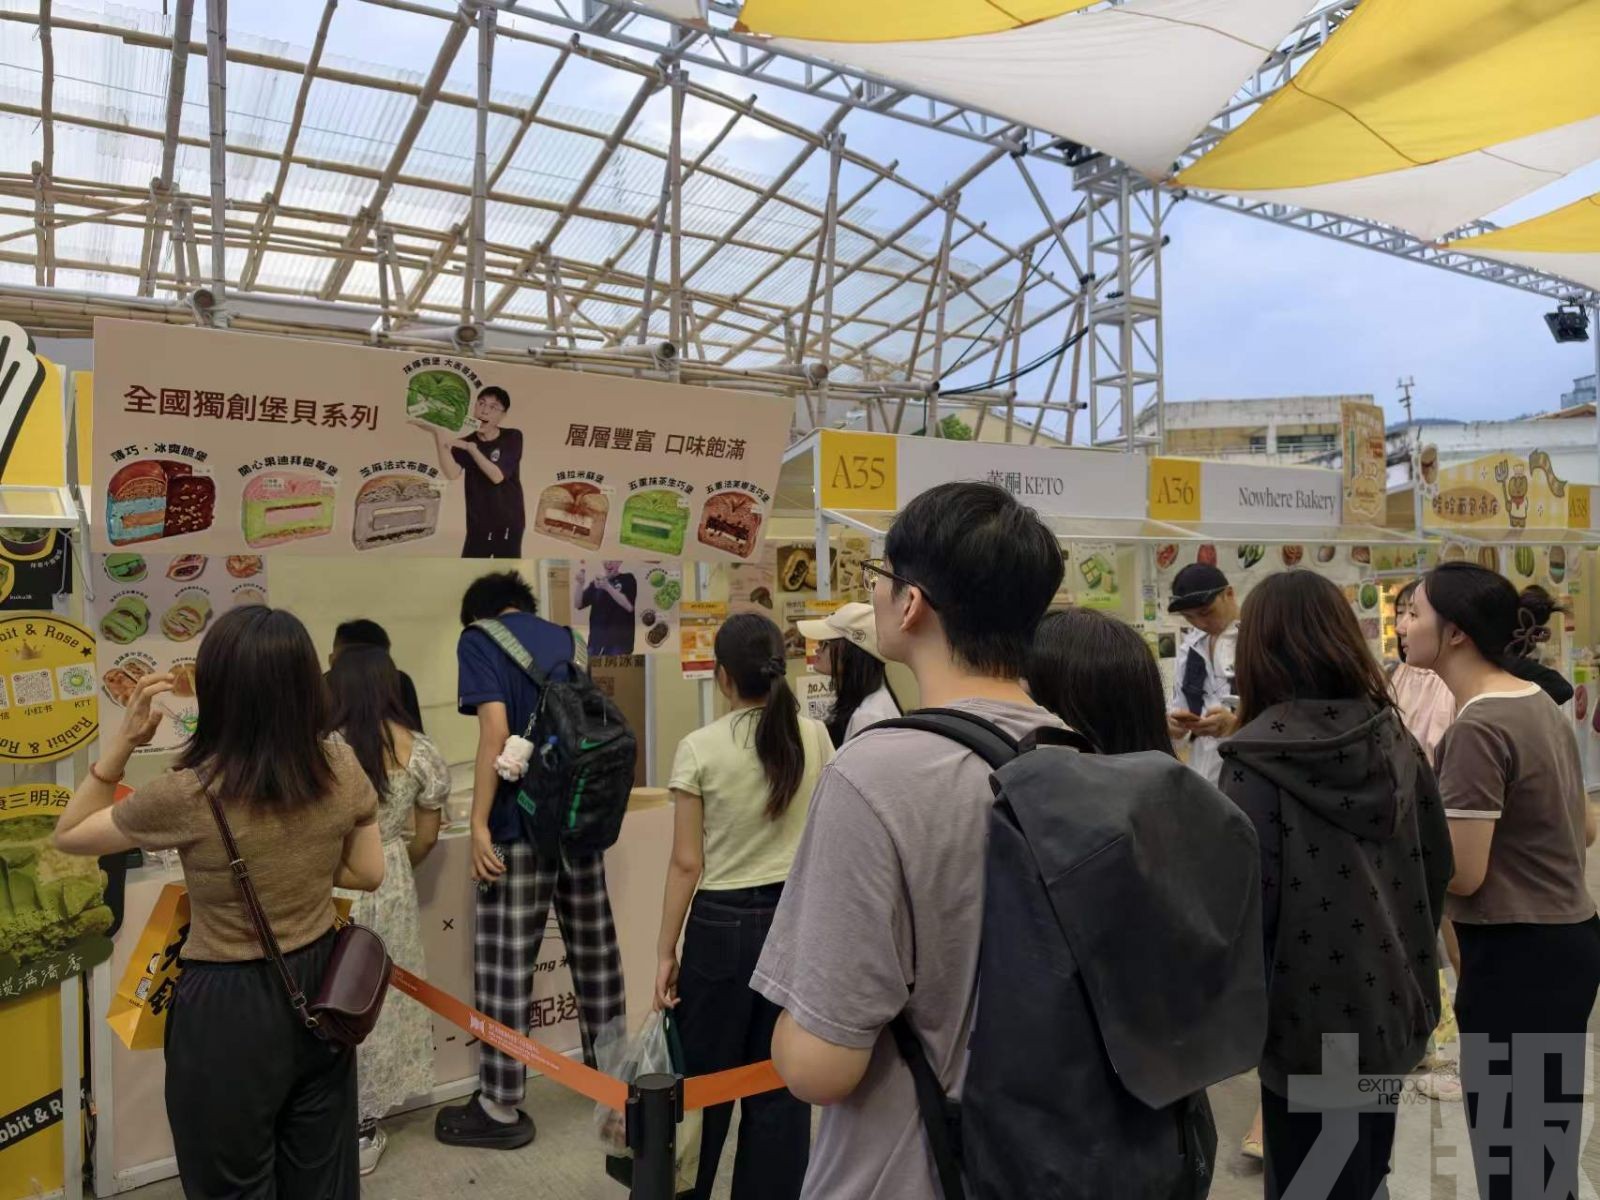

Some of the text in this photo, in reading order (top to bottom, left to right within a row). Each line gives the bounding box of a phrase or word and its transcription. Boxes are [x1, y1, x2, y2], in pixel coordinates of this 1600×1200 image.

[123, 385, 379, 431] 全國獨創堡貝系列
[565, 423, 747, 461] 層層豐富 口味飽滿
[831, 454, 886, 490] A35
[1024, 476, 1064, 496] KETO
[1157, 476, 1195, 505] A36
[1238, 486, 1293, 509] Nowhere
[1295, 489, 1336, 516] Bakery
[25, 623, 37, 635] &
[44, 625, 79, 648] Rose
[24, 704, 53, 716] 小红书
[48, 716, 93, 748] Rabbit
[28, 742, 40, 754] &
[34, 1107, 49, 1124] &
